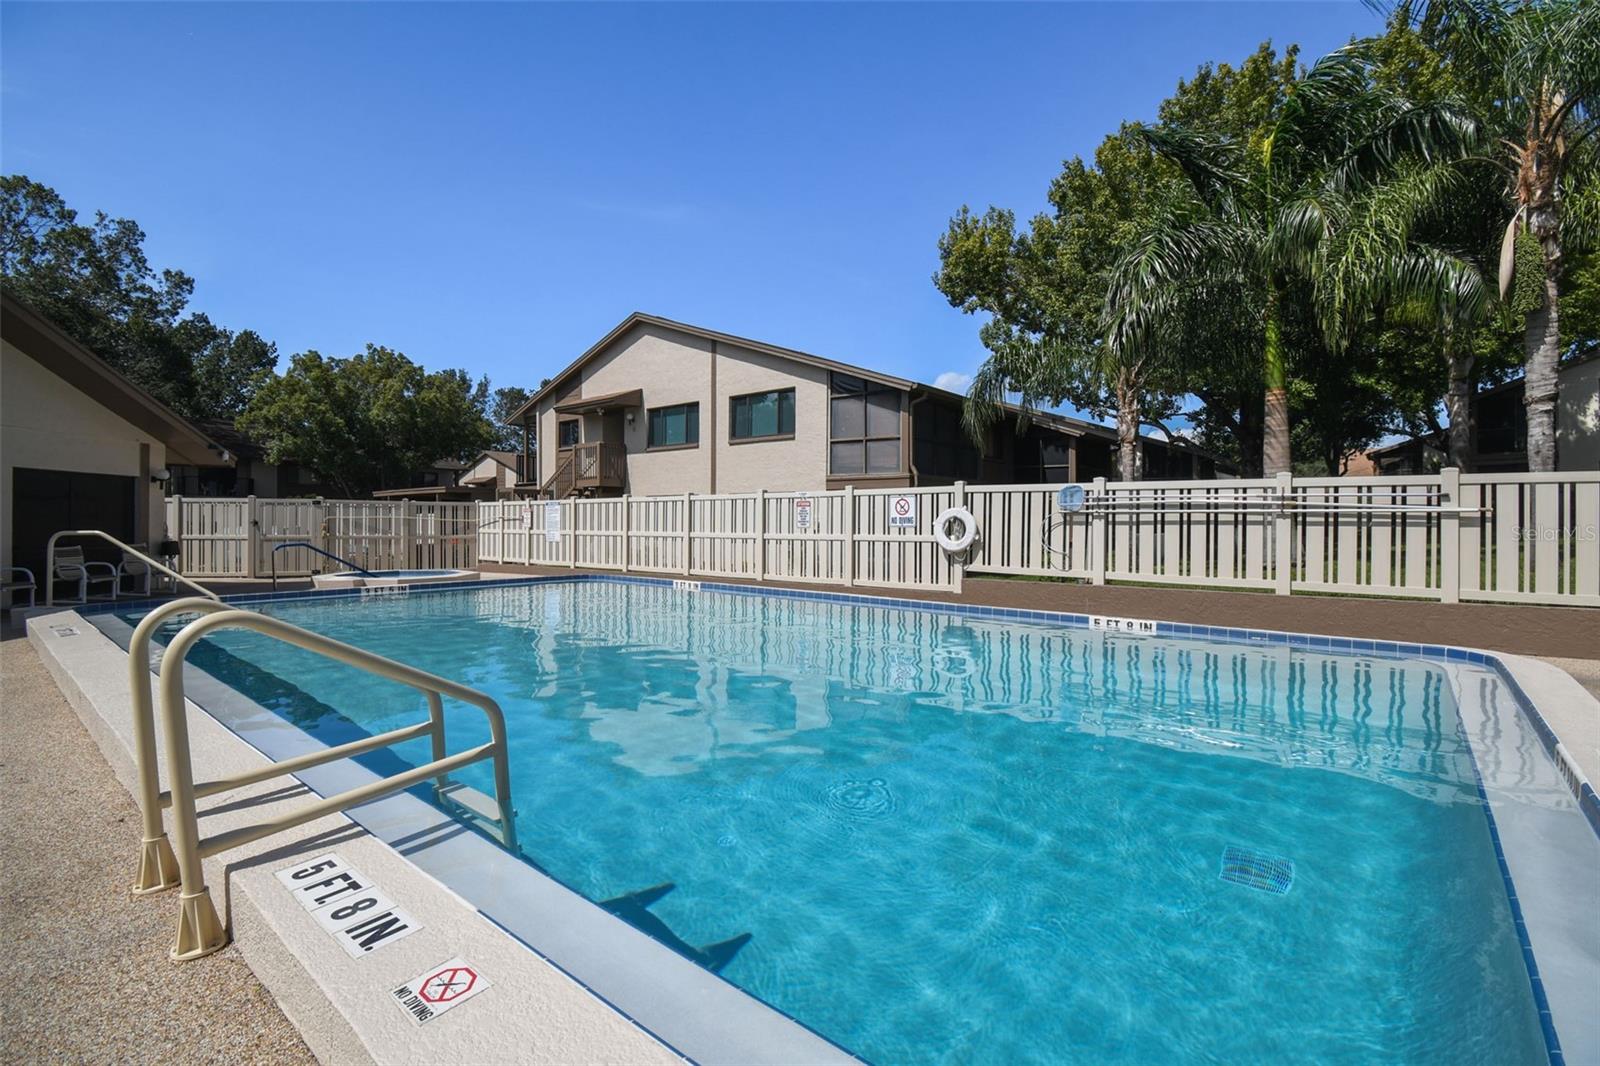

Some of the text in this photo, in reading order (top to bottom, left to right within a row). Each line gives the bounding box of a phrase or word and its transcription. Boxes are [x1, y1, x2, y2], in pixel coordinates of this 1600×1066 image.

[892, 516, 914, 524] NO DIVING
[292, 859, 338, 880] 5
[330, 897, 378, 921] 8
[344, 911, 409, 952] IN.
[393, 985, 434, 1022] NO DIVING
